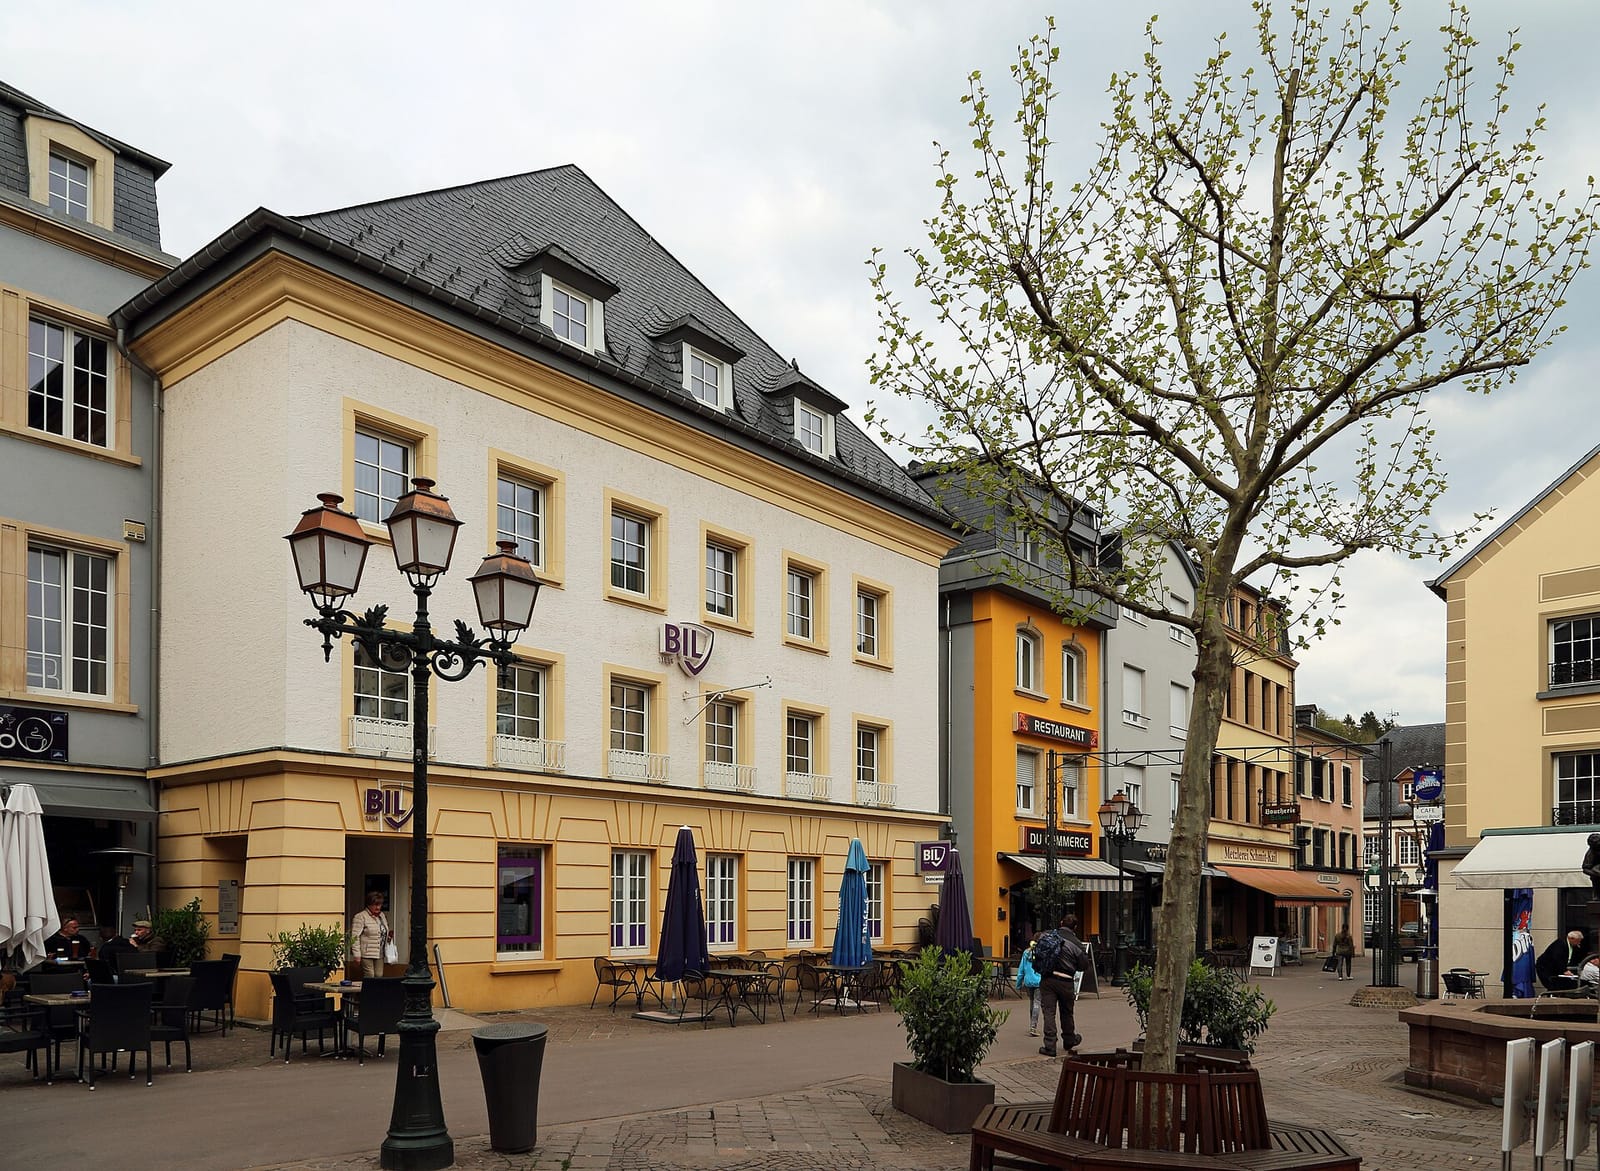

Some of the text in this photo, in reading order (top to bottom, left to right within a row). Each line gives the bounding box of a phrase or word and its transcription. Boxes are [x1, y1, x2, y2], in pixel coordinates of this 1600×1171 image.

[664, 623, 704, 659] BIL
[1034, 719, 1086, 742] RESTAURANT
[366, 788, 407, 816] BIL
[1029, 832, 1042, 845] DU
[923, 848, 941, 861] BIL
